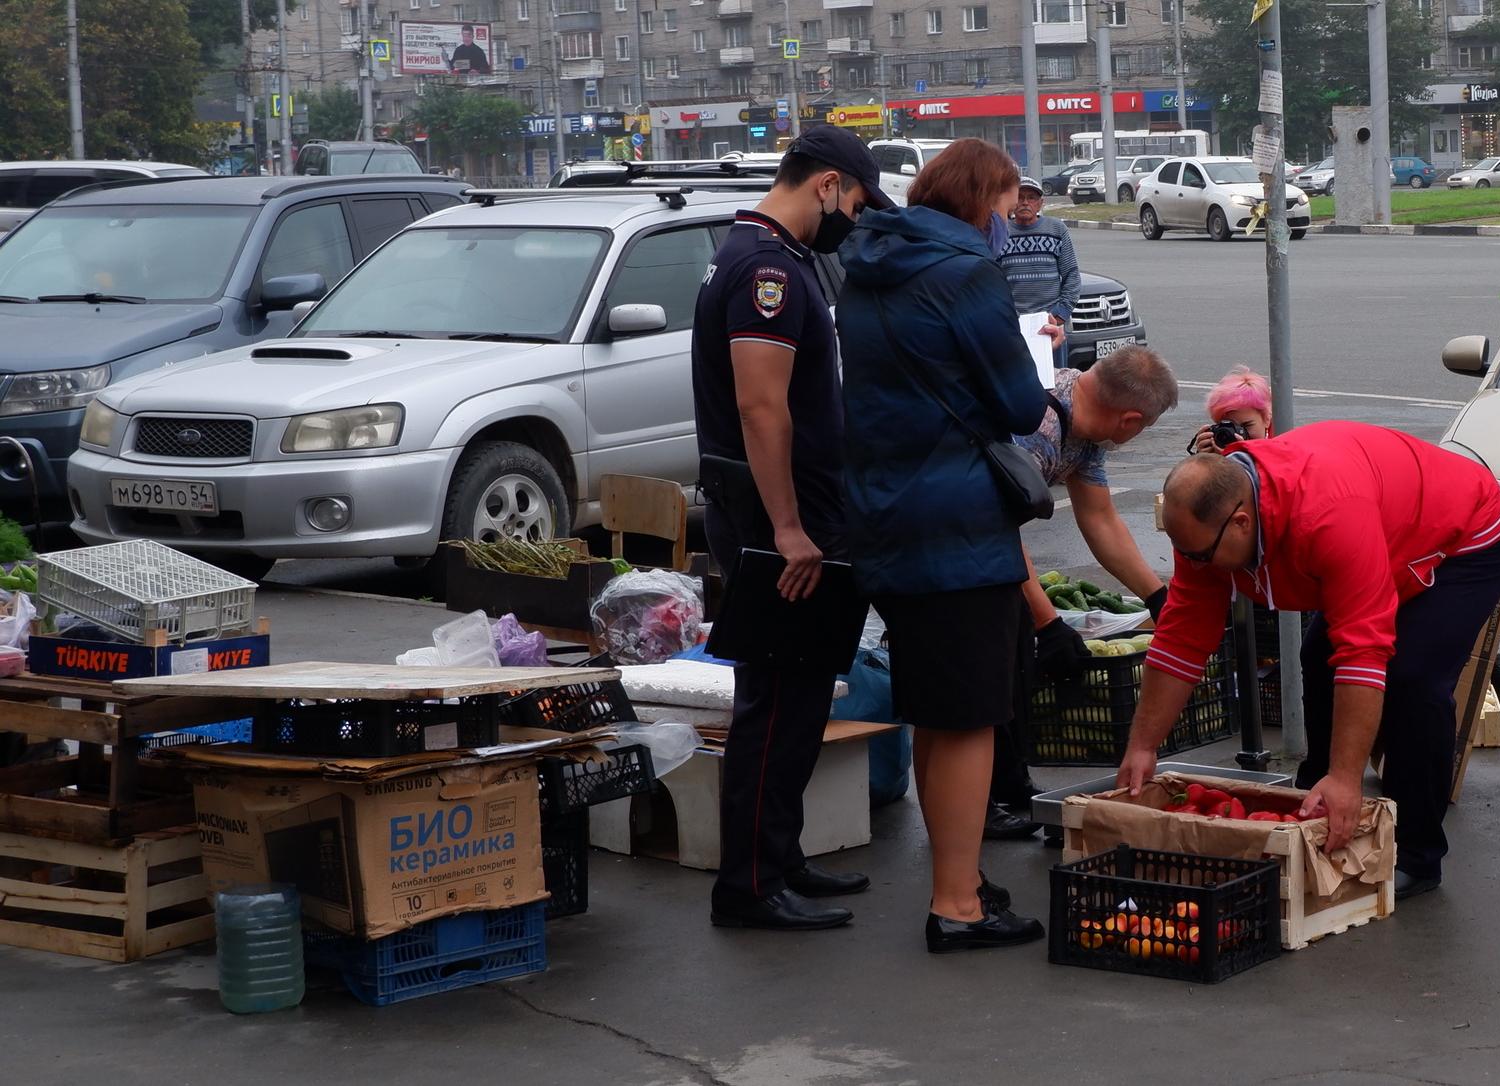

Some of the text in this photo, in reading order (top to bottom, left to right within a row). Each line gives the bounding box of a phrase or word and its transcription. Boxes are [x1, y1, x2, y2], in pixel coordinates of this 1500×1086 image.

[925, 103, 950, 114] МТС
[1056, 98, 1092, 110] МТС
[528, 118, 556, 132] АПТЕ
[118, 483, 208, 506] М698ТО 54
[55, 645, 129, 674] TÜRKIYE
[364, 776, 433, 797] SAMSUNG
[389, 804, 474, 853] БИО
[389, 831, 517, 875] керамика
[391, 856, 517, 891] Антибактериальное покрытие
[398, 907, 427, 920] гарант
[406, 894, 423, 912] 10
